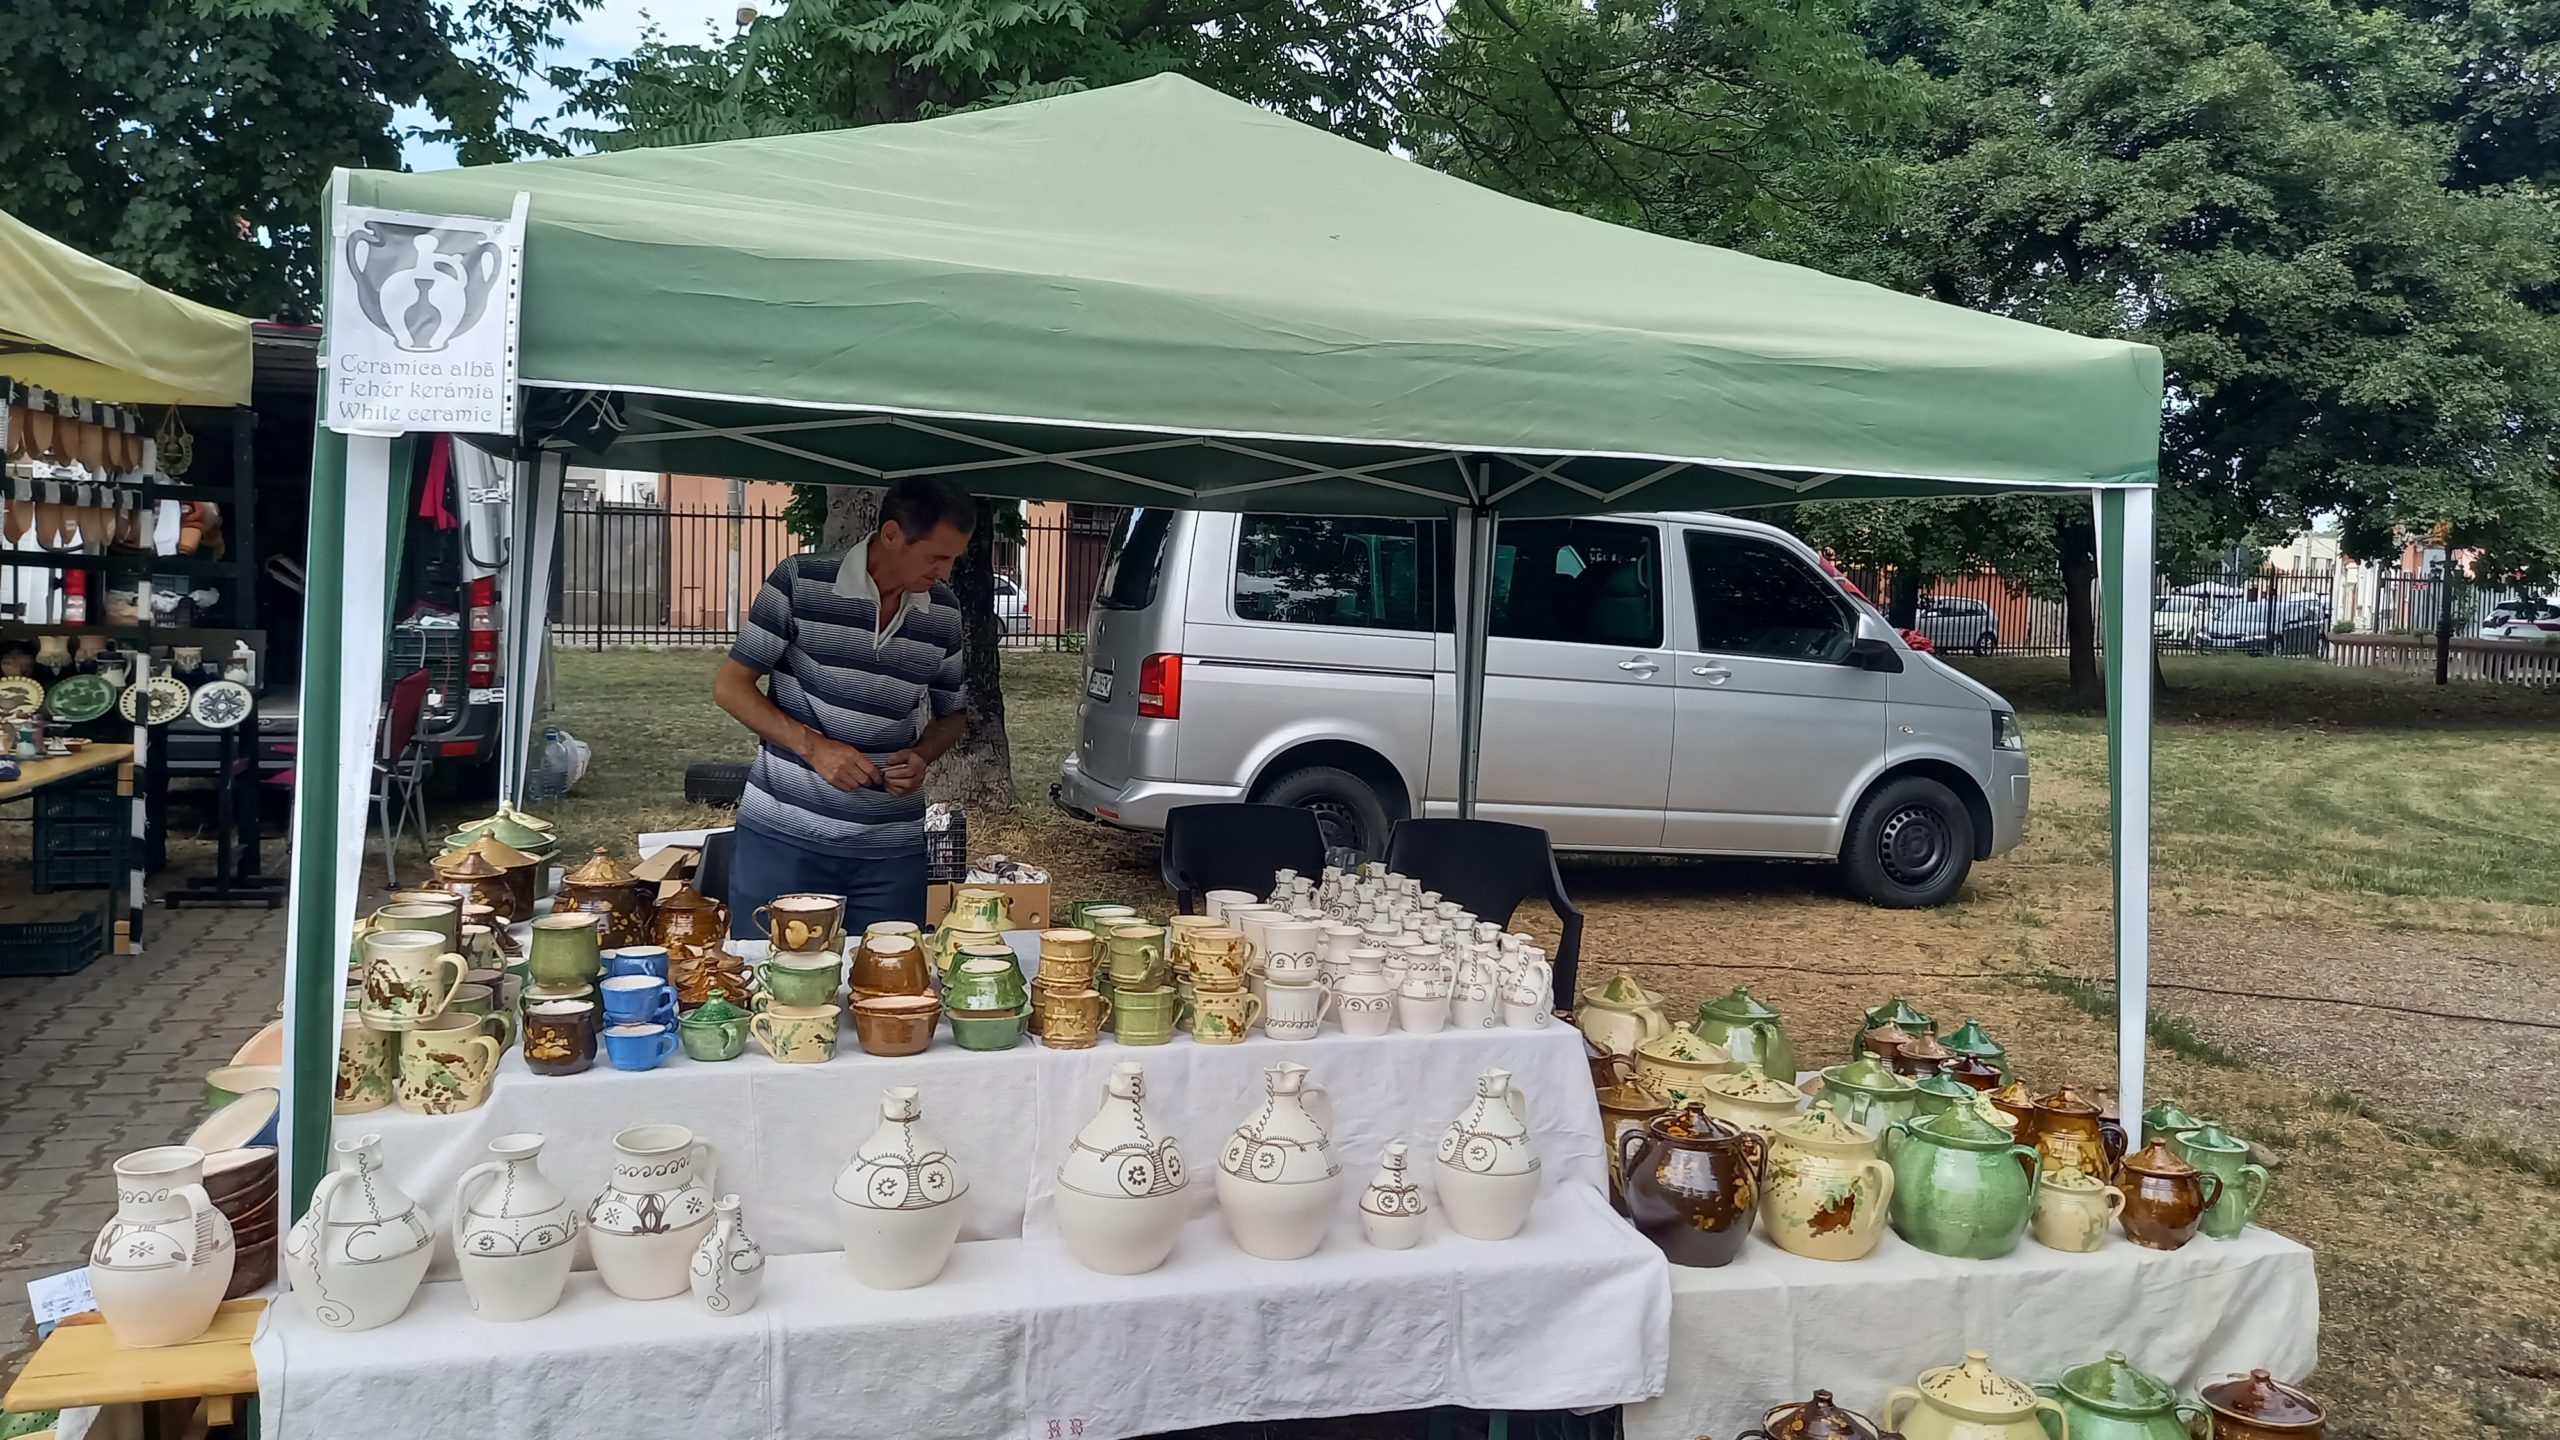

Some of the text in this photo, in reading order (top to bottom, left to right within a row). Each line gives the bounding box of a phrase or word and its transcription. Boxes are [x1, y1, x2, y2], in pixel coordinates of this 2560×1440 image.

[340, 354, 443, 376] Ceramica
[339, 377, 494, 400] Fehér kerámia
[339, 401, 492, 423] White ceramic
